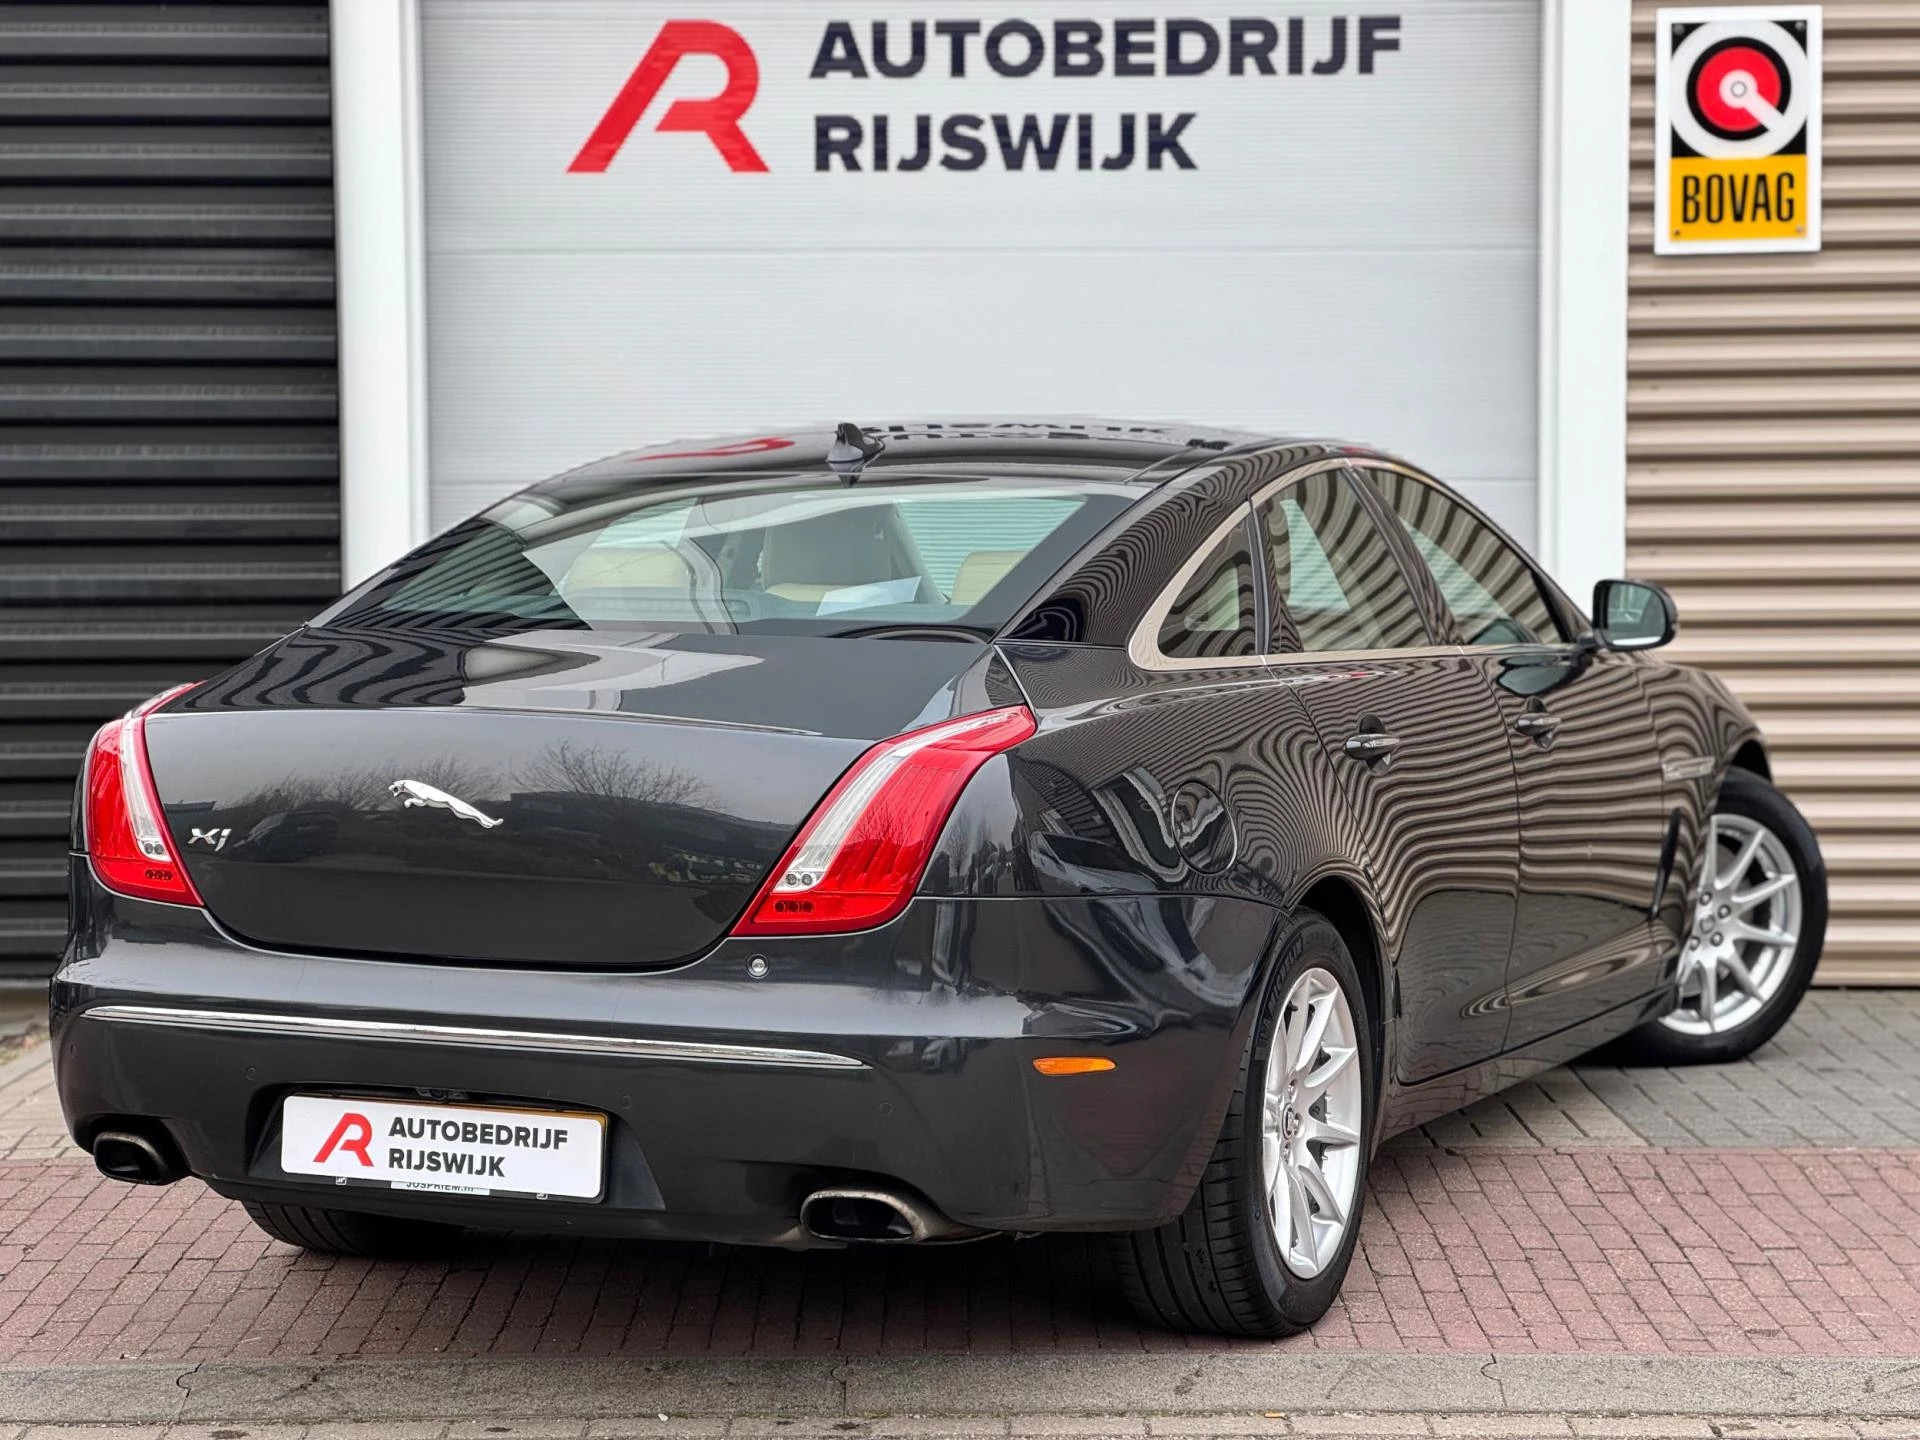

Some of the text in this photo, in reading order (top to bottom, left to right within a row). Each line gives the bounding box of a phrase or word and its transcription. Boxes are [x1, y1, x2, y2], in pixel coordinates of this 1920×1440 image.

[810, 15, 1401, 79] AUTOBEDRIJF
[814, 113, 1198, 172] RIJSWIJK
[1682, 172, 1795, 224] BOVAG
[388, 1116, 568, 1150] AUTOBEDRIJF
[388, 1147, 505, 1178] RIJSWIJK
